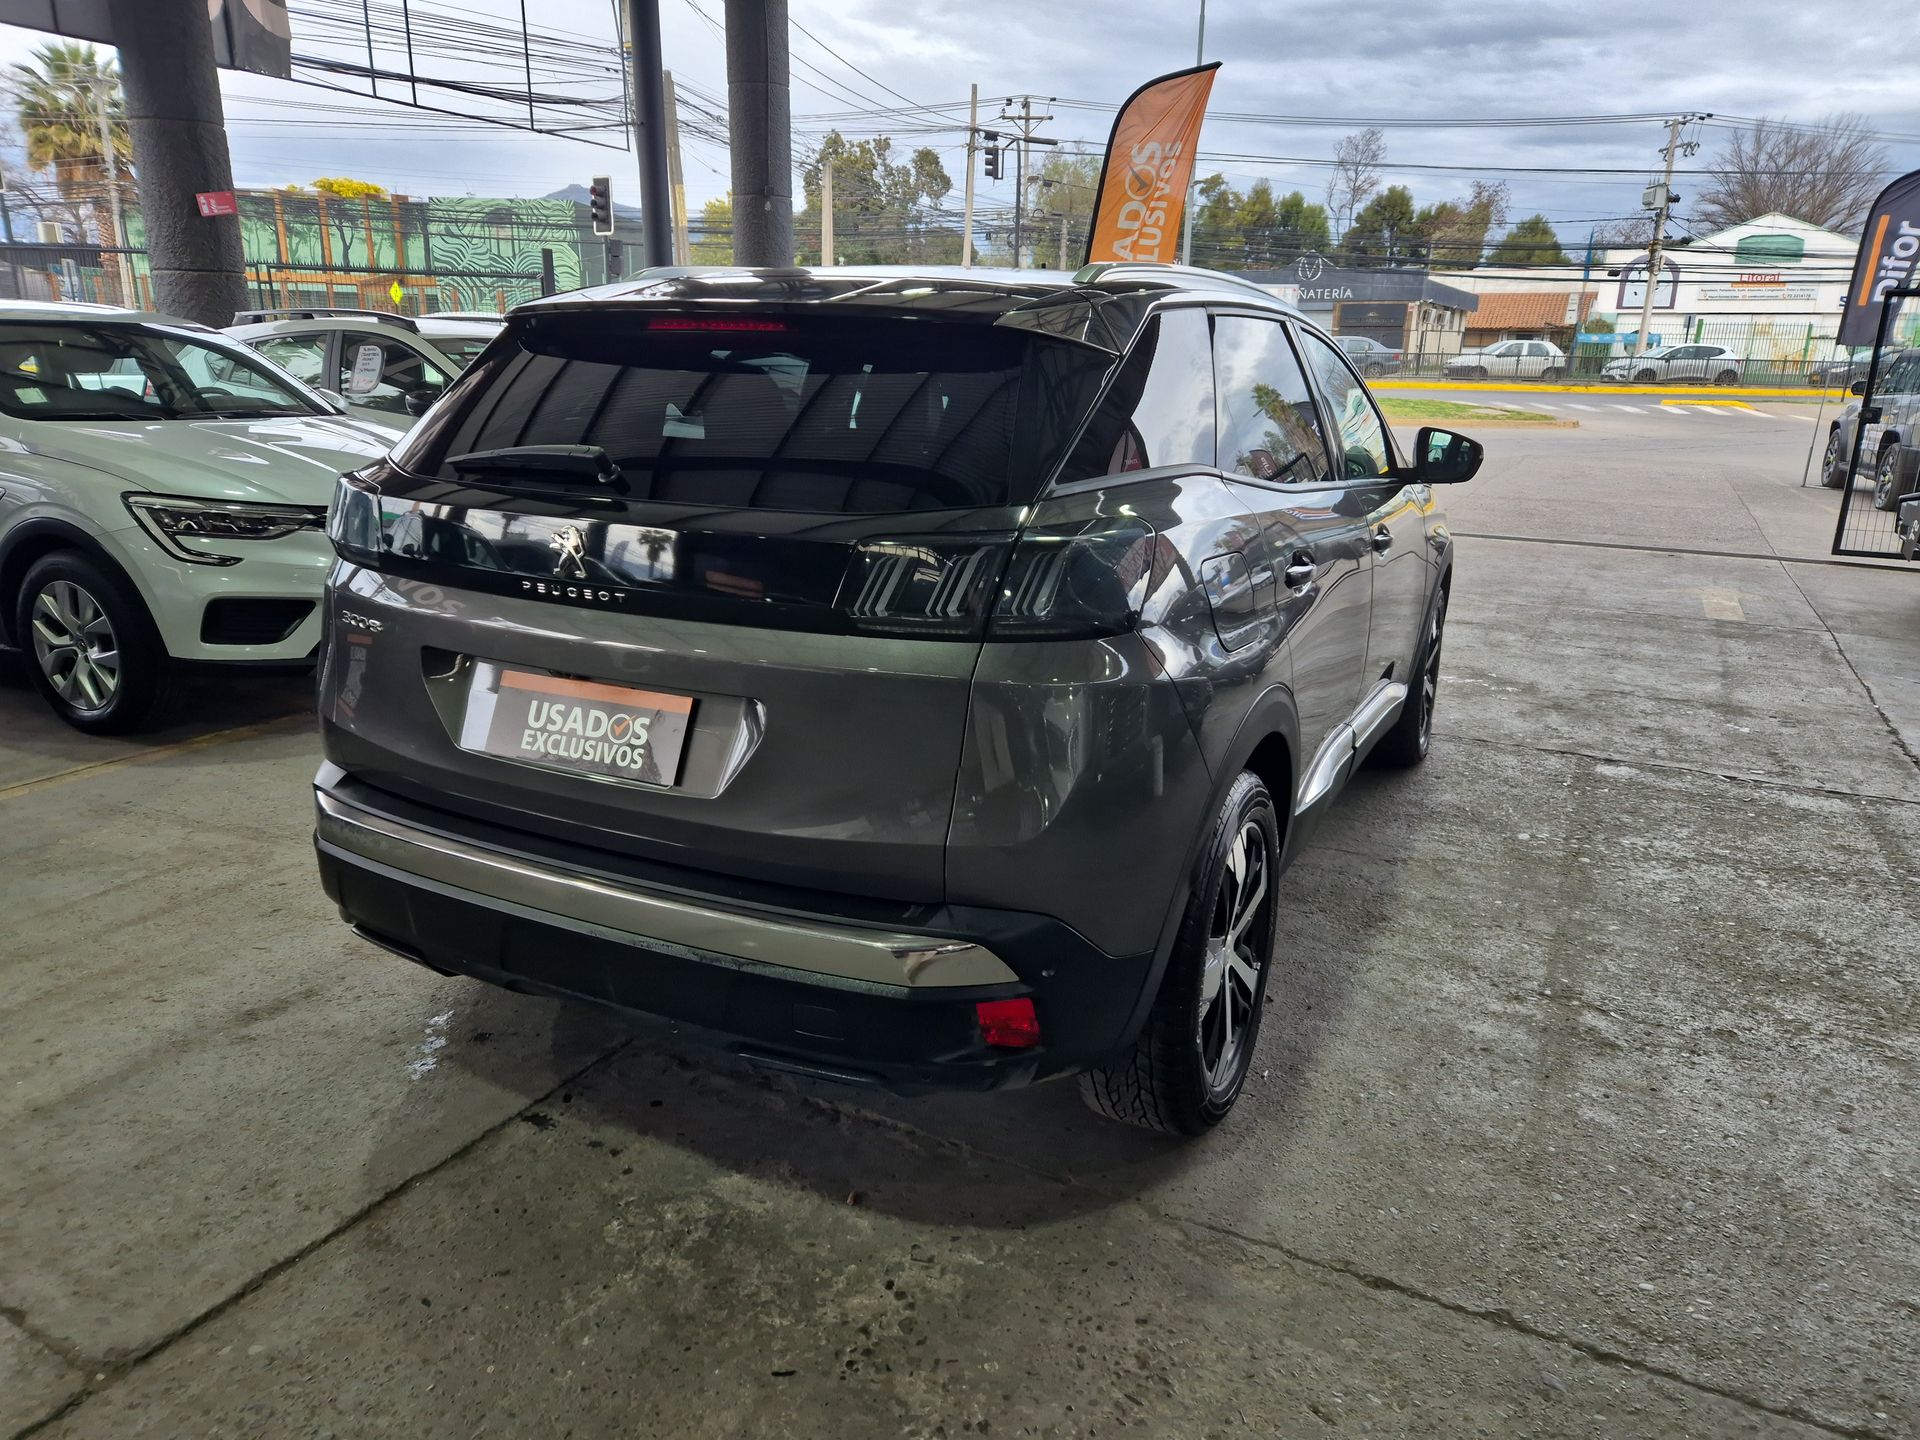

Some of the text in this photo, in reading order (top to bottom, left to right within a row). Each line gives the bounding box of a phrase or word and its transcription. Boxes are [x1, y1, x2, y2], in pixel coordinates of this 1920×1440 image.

[1873, 221, 1920, 302] Difor
[1740, 272, 1780, 283] Litoral
[522, 581, 625, 603] PEUGEOT
[342, 610, 384, 632] 3008
[527, 700, 650, 746] USADOS
[520, 729, 645, 770] EXCLUSIVOS
